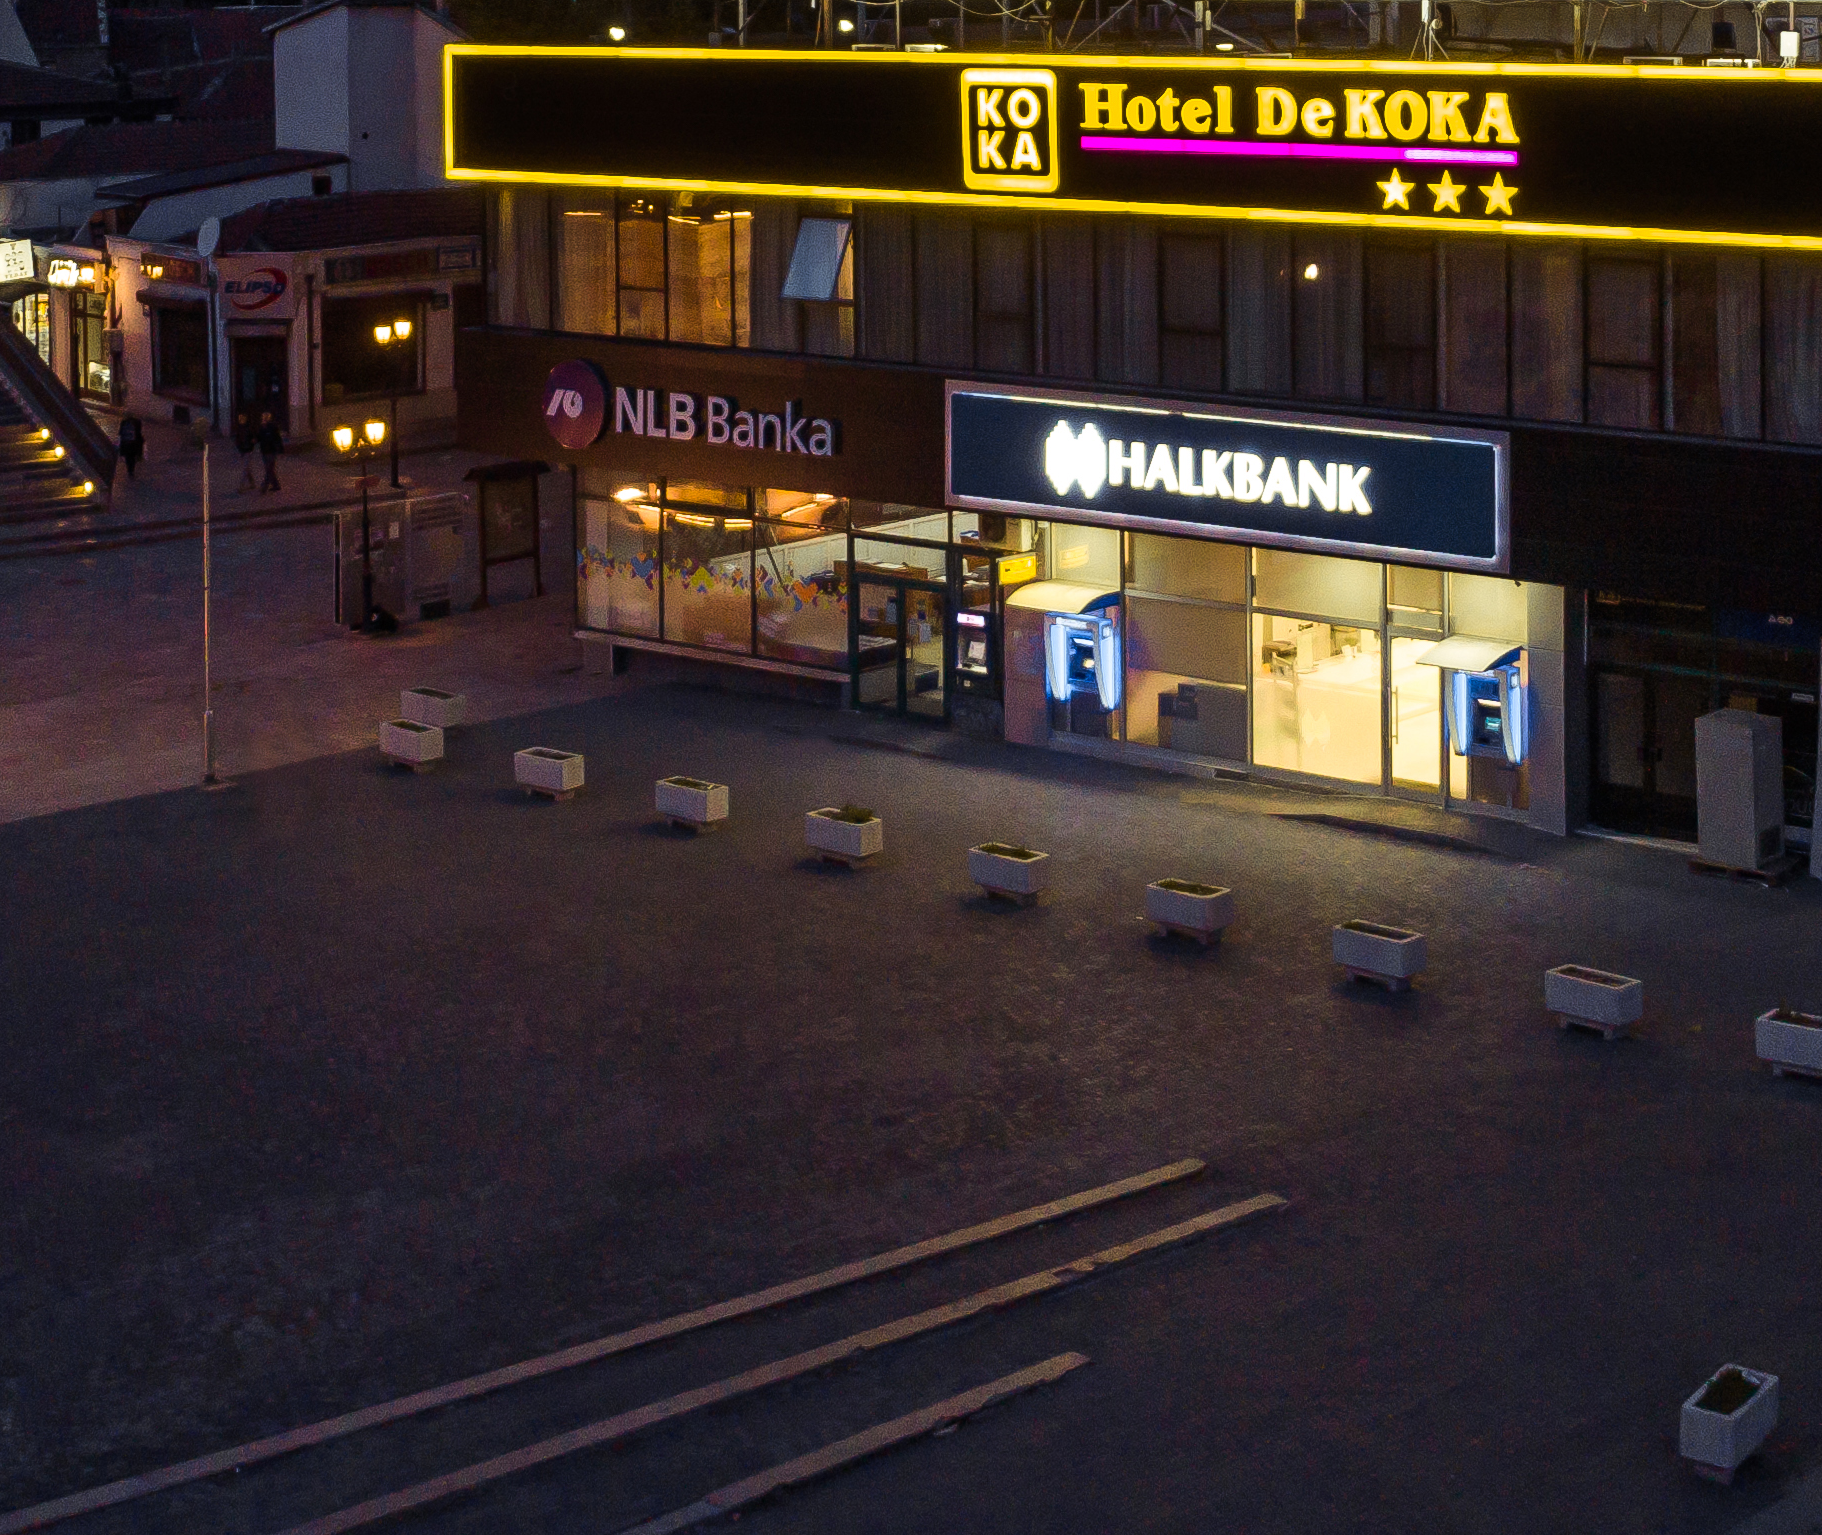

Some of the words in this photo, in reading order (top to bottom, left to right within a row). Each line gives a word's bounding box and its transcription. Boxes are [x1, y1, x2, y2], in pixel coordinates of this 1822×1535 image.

[1079, 82, 1235, 134] Hotel
[225, 280, 286, 295] ELIPSO
[615, 386, 696, 441] NLB
[707, 395, 833, 457] Banka
[1107, 438, 1373, 515] HALKBANK
